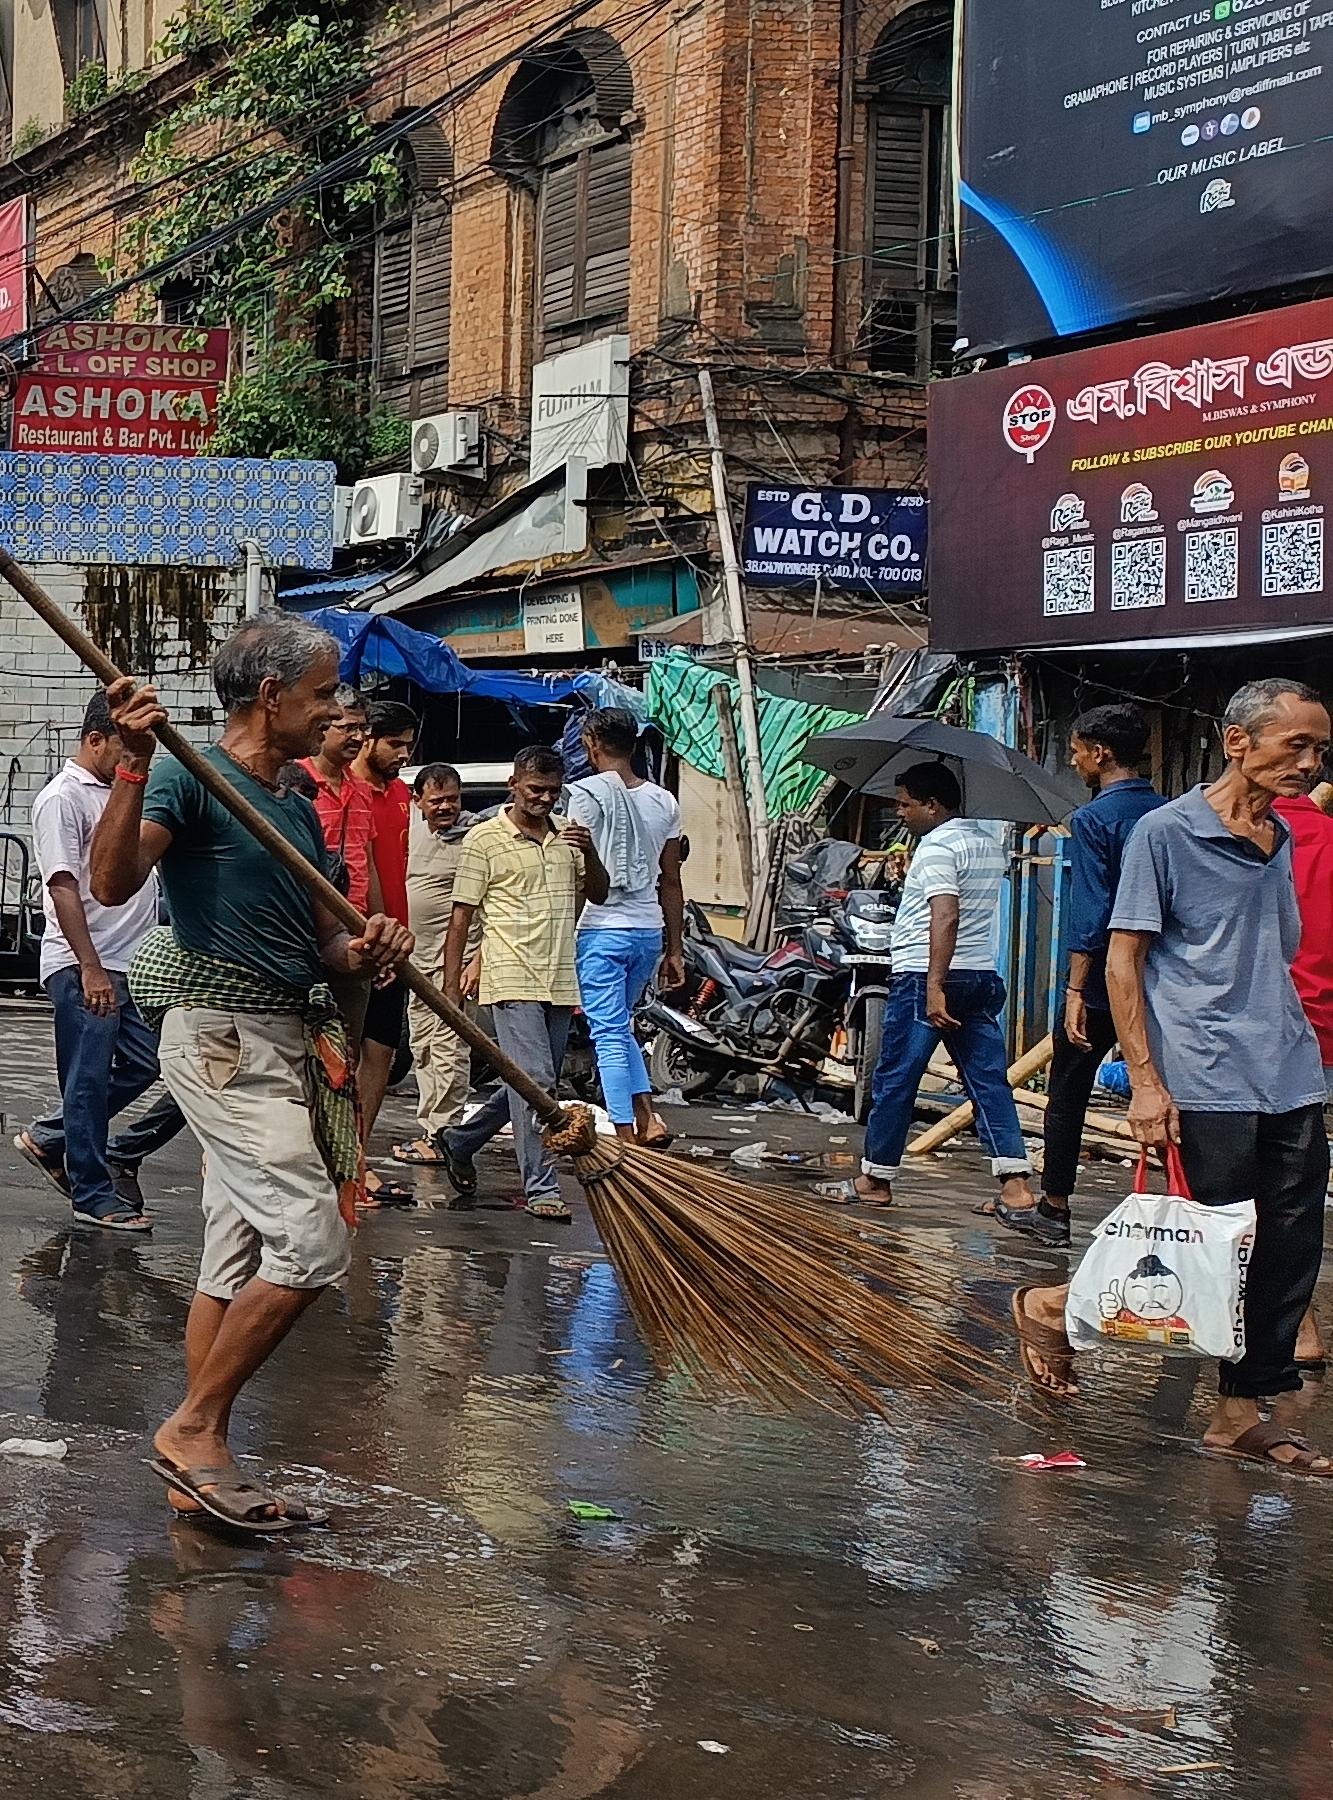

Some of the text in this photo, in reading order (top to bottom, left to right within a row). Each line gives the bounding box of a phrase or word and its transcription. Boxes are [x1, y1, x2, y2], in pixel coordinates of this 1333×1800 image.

[1136, 10, 1211, 43] CONTACT US
[1147, 46, 1169, 66] FOR
[1169, 28, 1225, 58] REPAIRING
[1225, 25, 1232, 40] &
[1234, 6, 1292, 37] SERVICING
[1293, 0, 1312, 17] OF
[1063, 76, 1129, 109] GRAMAPHONE
[1135, 61, 1177, 86] RECORD
[1177, 46, 1223, 73] PLAYERS
[1229, 35, 1259, 56] TURN
[1261, 22, 1301, 46] TABLES
[1143, 40, 1311, 101] MUSIC SYSTEMS AMPLIFIERS etc
[1152, 65, 1324, 125] mb_symphony@rediffmail.com
[1157, 137, 1286, 184] OUR MUSIC LABEL
[57, 354, 80, 373] L.
[87, 355, 137, 377] OFF
[145, 357, 217, 377] SHOP
[538, 378, 602, 422] FUJIFILM
[1259, 393, 1317, 413] SYMPHONY
[1009, 409, 1051, 427] STOP
[18, 423, 98, 446] Restaurant
[102, 427, 114, 446] &
[119, 428, 145, 448] Bar
[148, 428, 176, 450] Pvt.
[1071, 453, 1121, 472] FOLLOW
[1121, 451, 1130, 464] &
[1132, 439, 1202, 463] SUBSCRIBE
[1204, 434, 1232, 450] OUR
[1234, 423, 1297, 446] YOUTUBE
[757, 490, 790, 502] ESTD
[791, 492, 832, 522] G.
[839, 493, 880, 525] D.
[753, 527, 920, 561] WATCH CO.
[526, 593, 569, 606] DEVELOPING
[526, 614, 558, 626] PRINTING
[559, 612, 579, 623] DONE
[545, 633, 564, 643] HERE
[859, 903, 897, 915] POLICE
